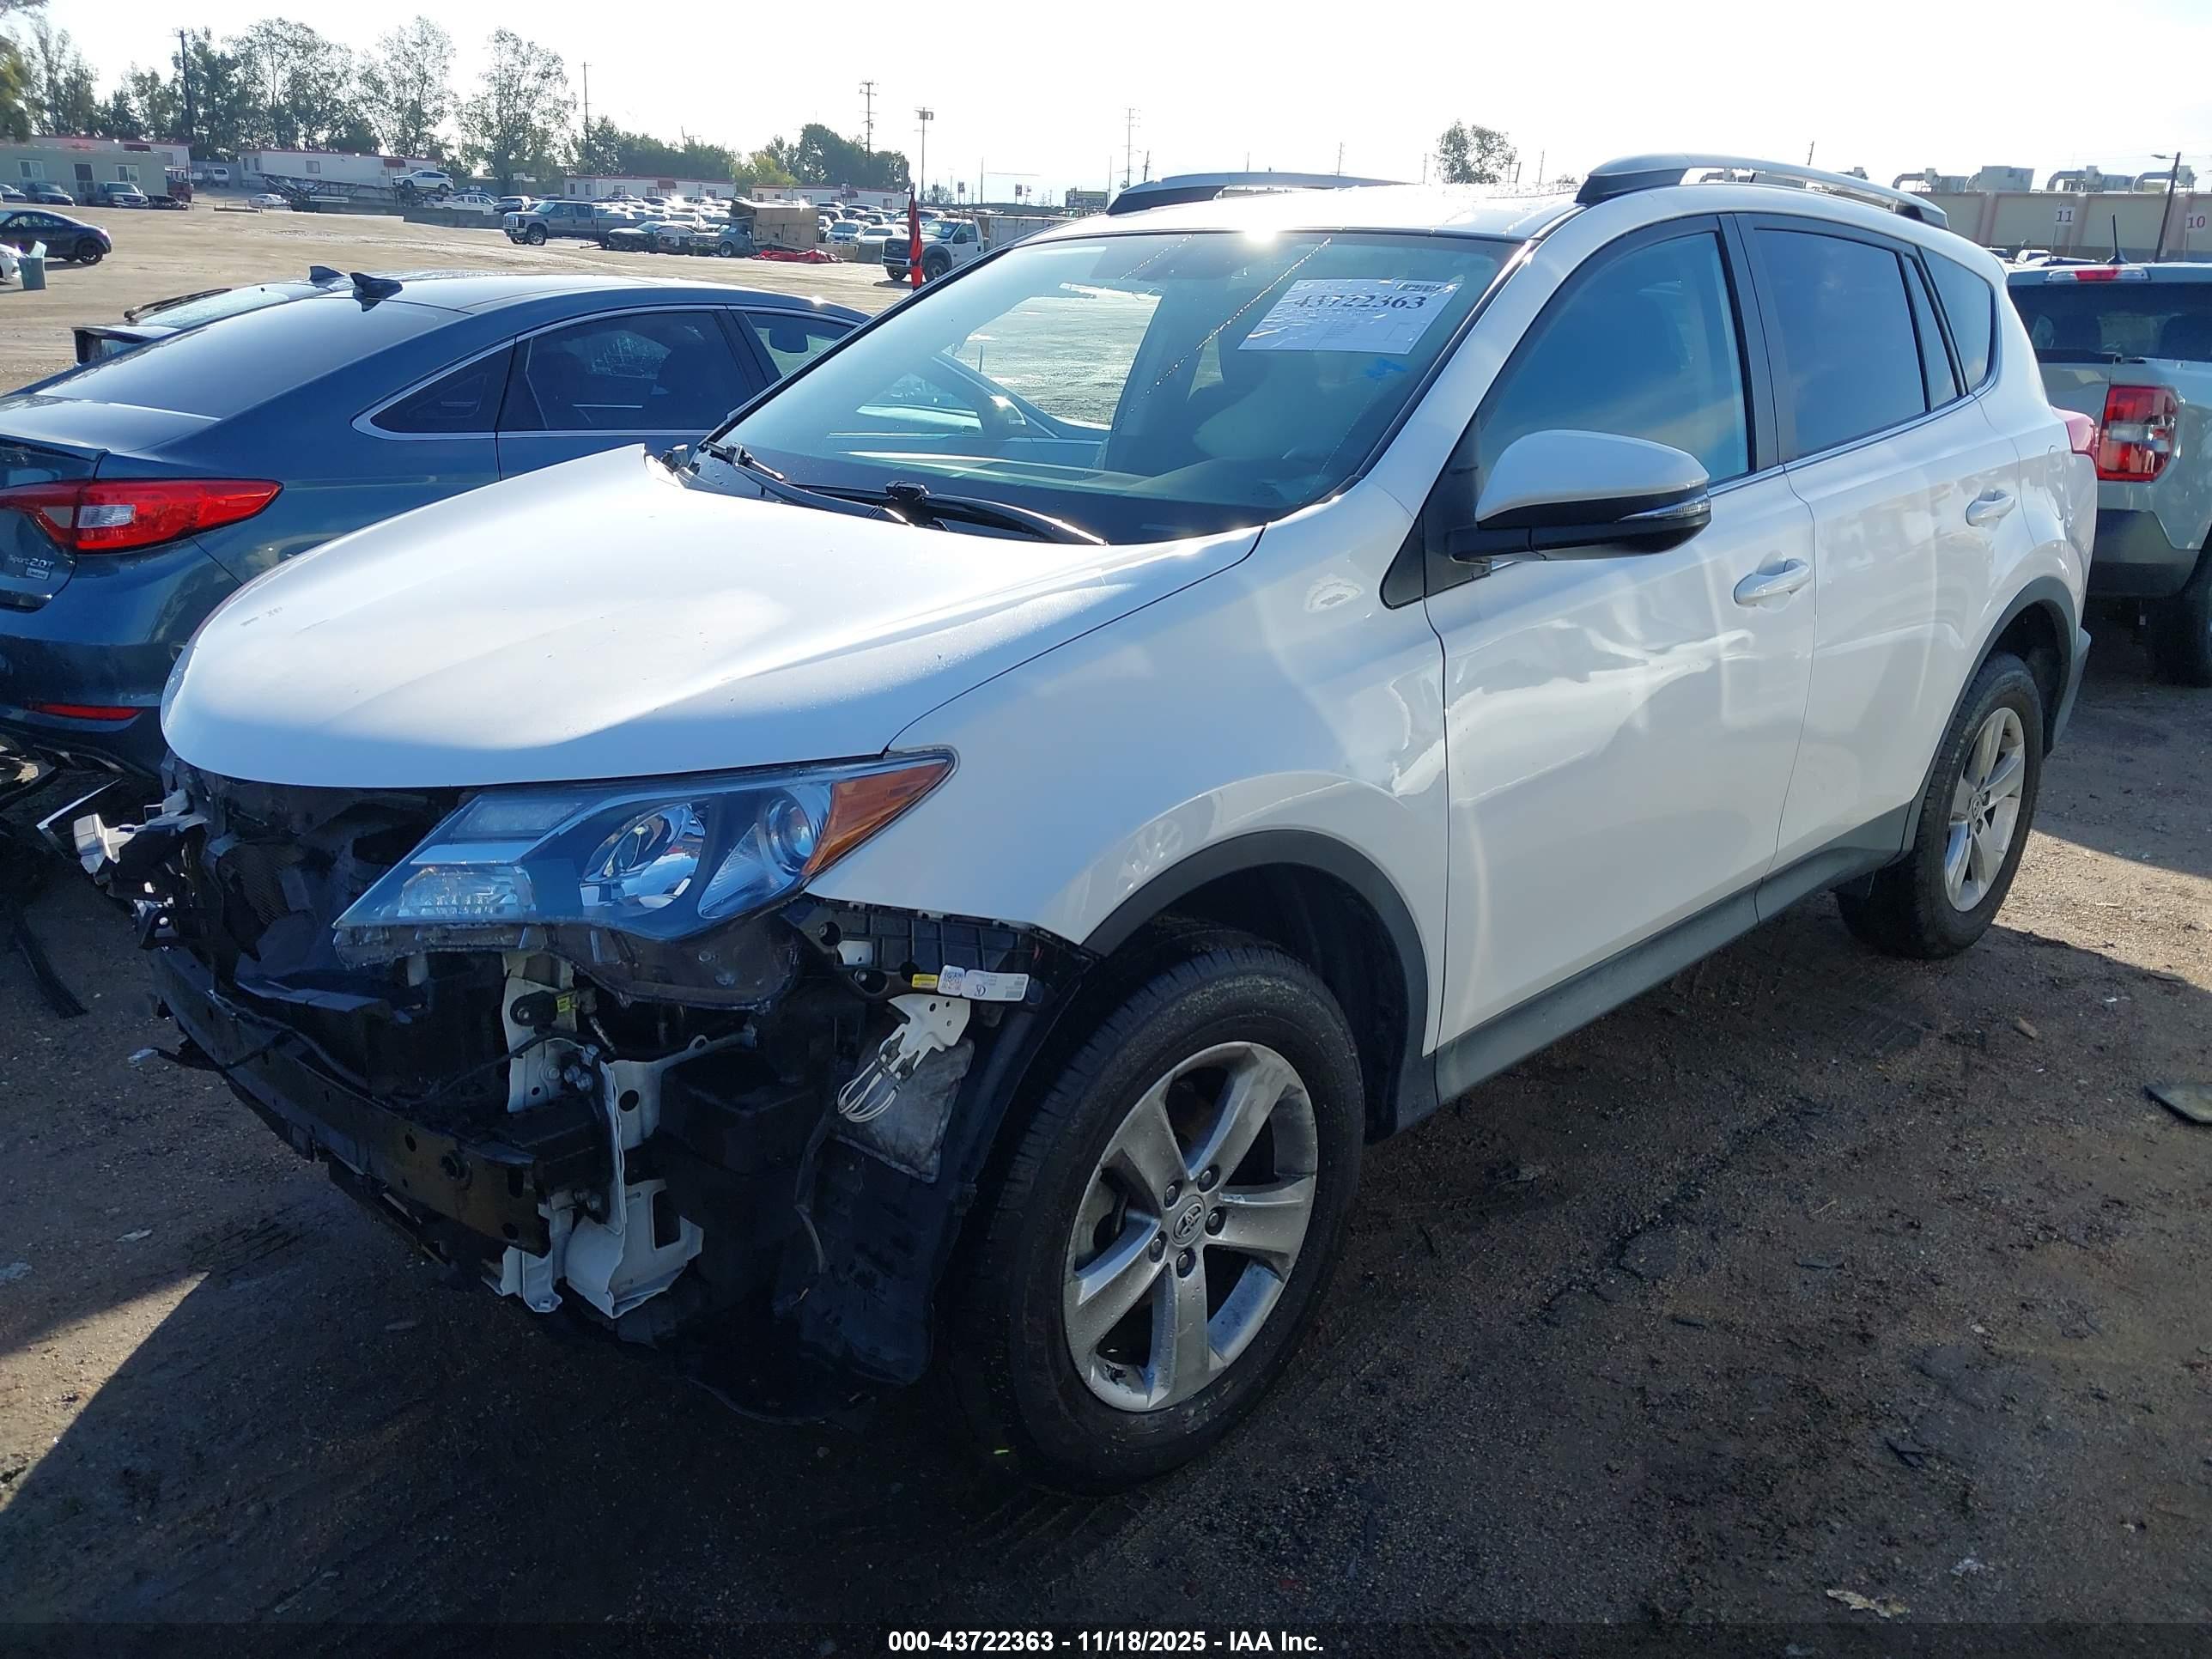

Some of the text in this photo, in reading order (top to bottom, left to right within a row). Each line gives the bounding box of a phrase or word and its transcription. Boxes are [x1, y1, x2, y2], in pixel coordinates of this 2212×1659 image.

[2056, 210, 2073, 222] 11
[2187, 216, 2206, 228] 10
[1294, 295, 1426, 309] 43722363
